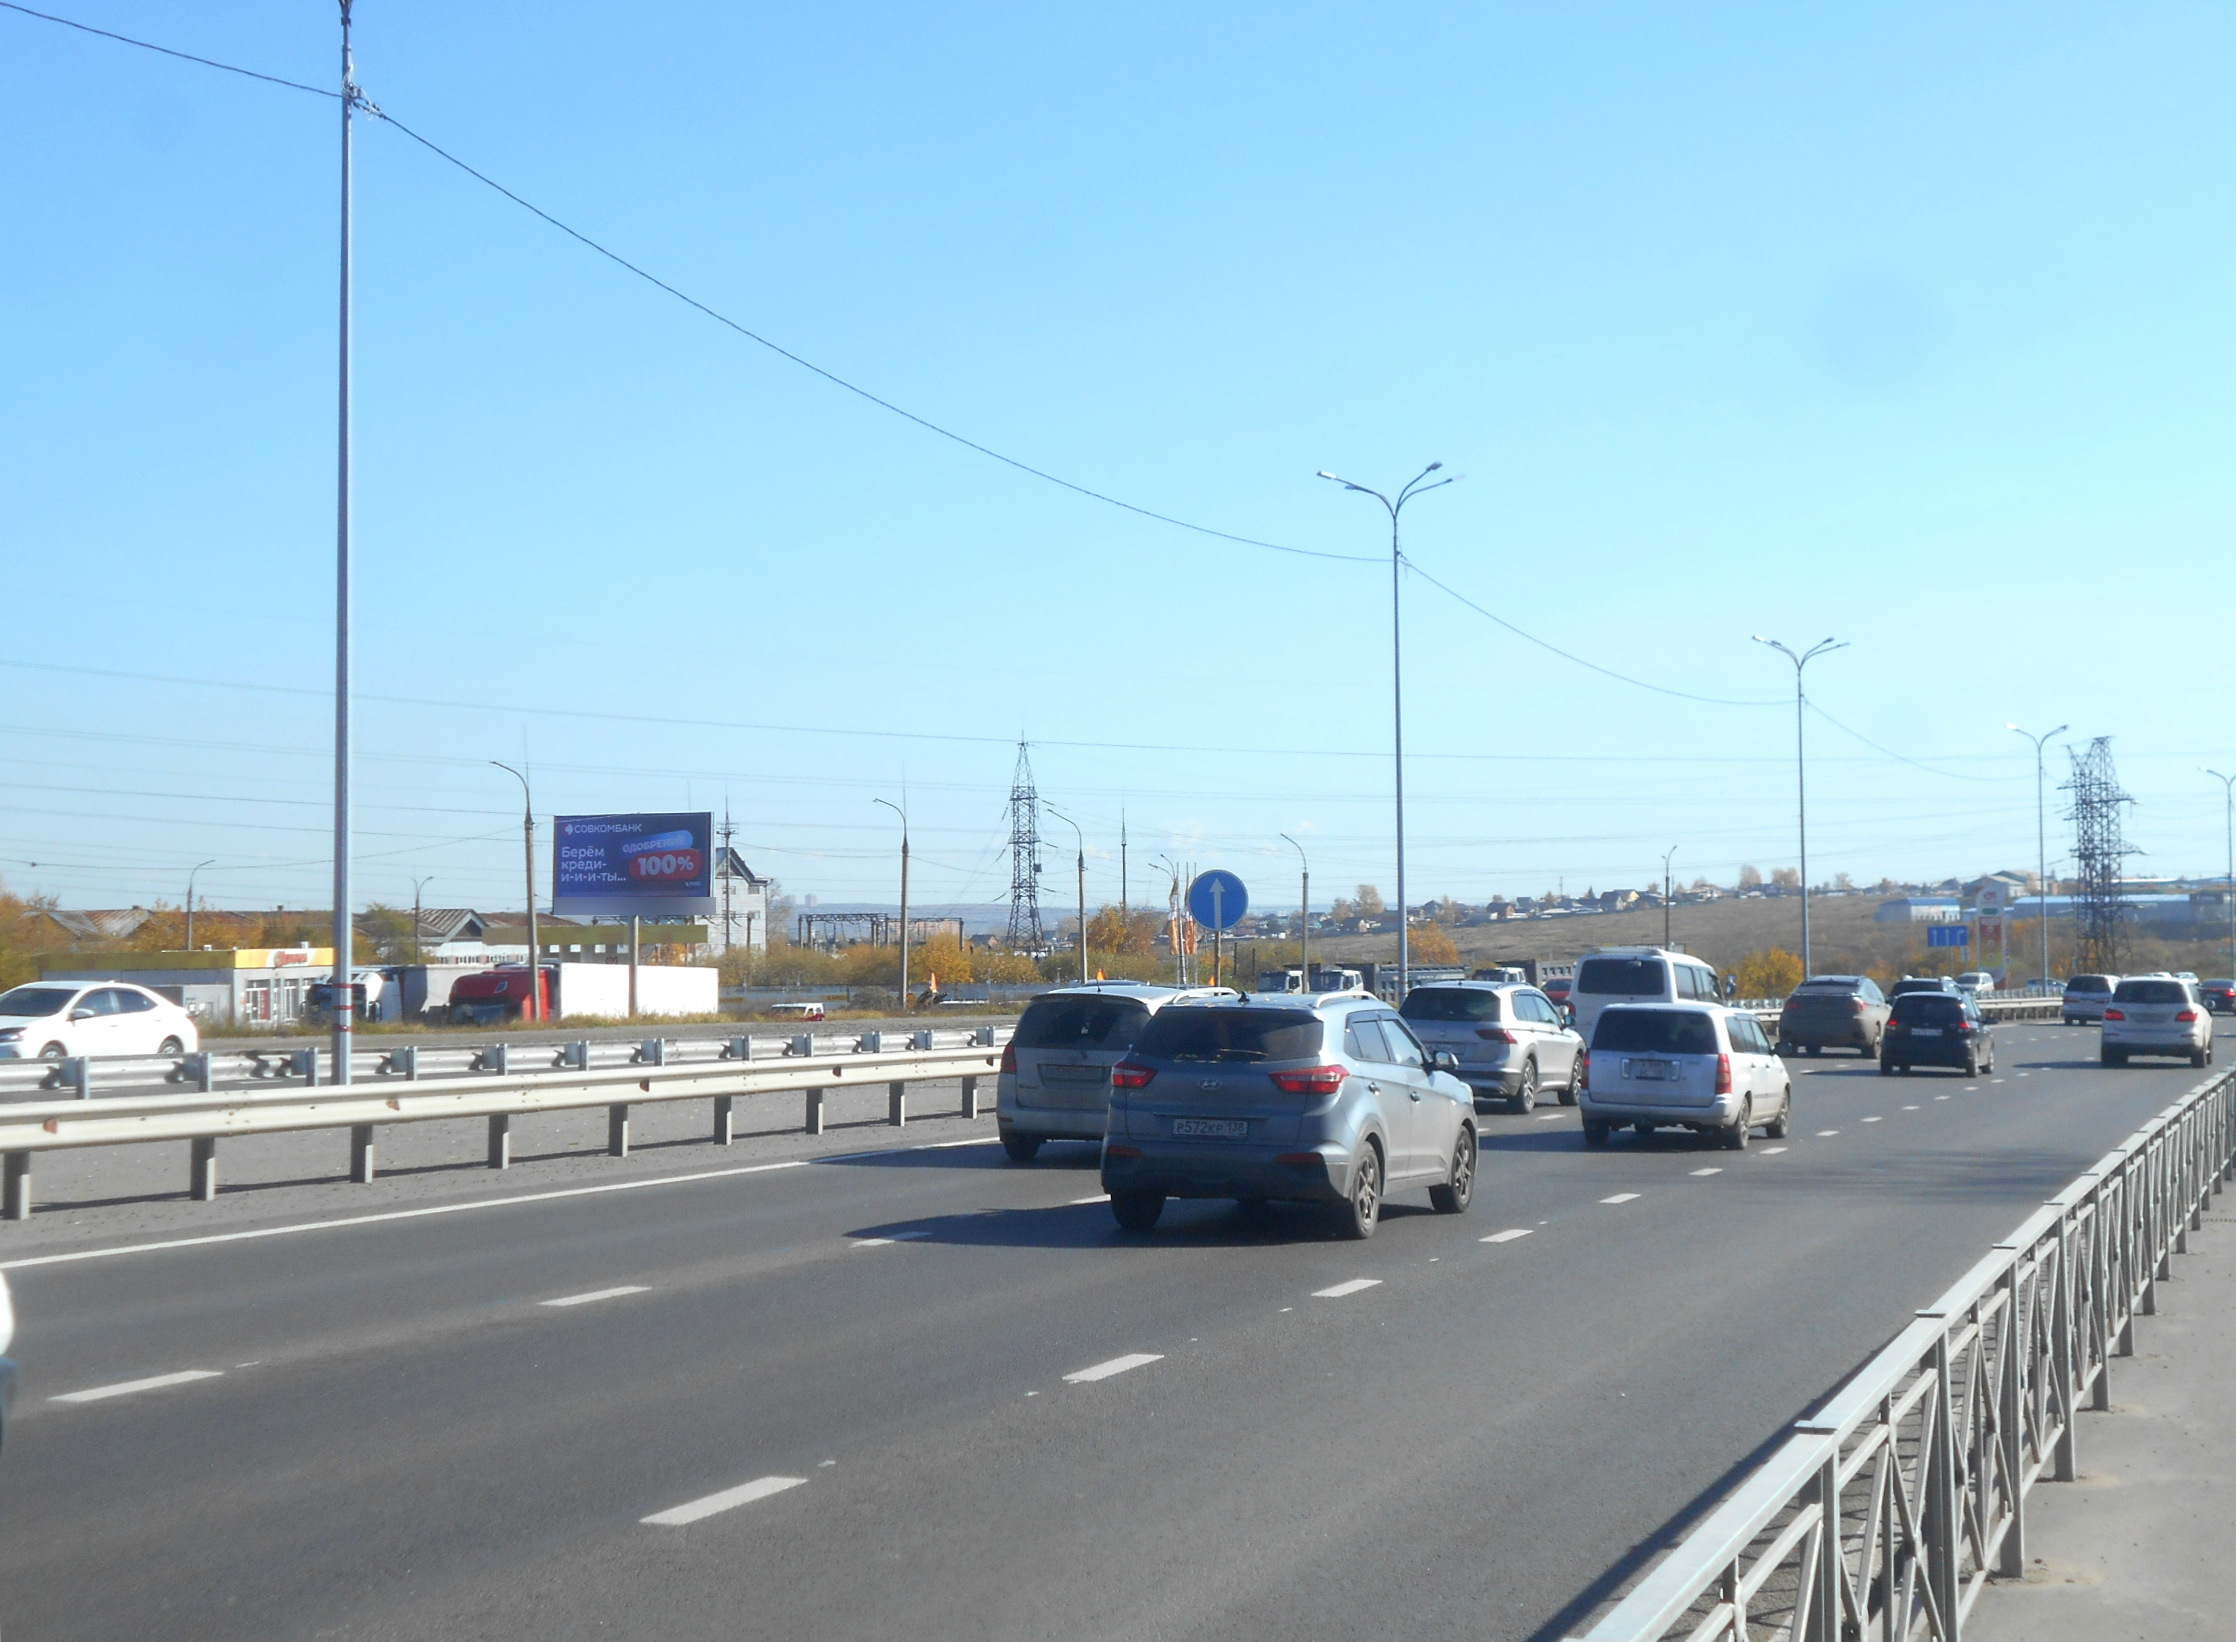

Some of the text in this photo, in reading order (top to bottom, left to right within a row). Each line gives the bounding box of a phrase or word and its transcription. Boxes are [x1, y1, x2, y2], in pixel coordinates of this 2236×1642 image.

[574, 823, 642, 834] СОВКОМБАНК
[561, 845, 605, 859] Берём
[561, 861, 607, 872] креди-
[637, 854, 694, 876] 100%
